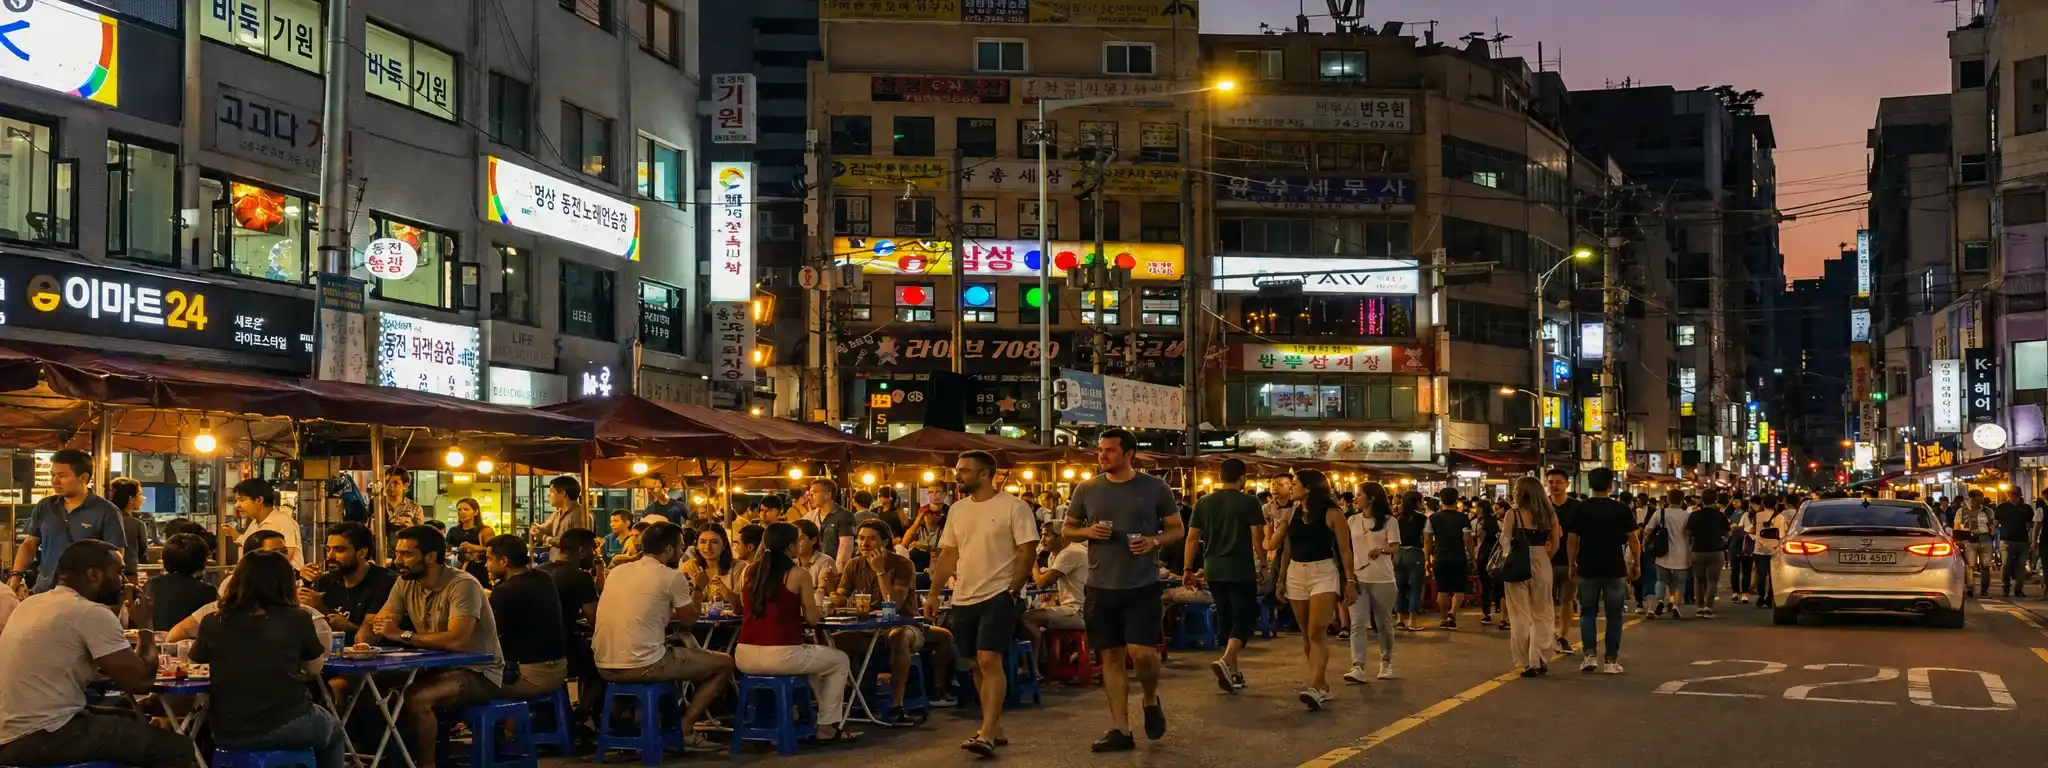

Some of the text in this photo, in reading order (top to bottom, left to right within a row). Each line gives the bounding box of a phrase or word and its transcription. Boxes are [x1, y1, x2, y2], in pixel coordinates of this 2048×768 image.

[213, 0, 314, 59] 바둑 기원
[368, 52, 447, 107] 바둑 기원
[219, 94, 300, 148] 고고다
[718, 84, 743, 129] 기원
[65, 276, 208, 337] 이마트24
[384, 332, 406, 359] 동전
[512, 331, 534, 346] LIFE
[1974, 382, 1990, 411] 헤어
[1651, 659, 2018, 711] 220
